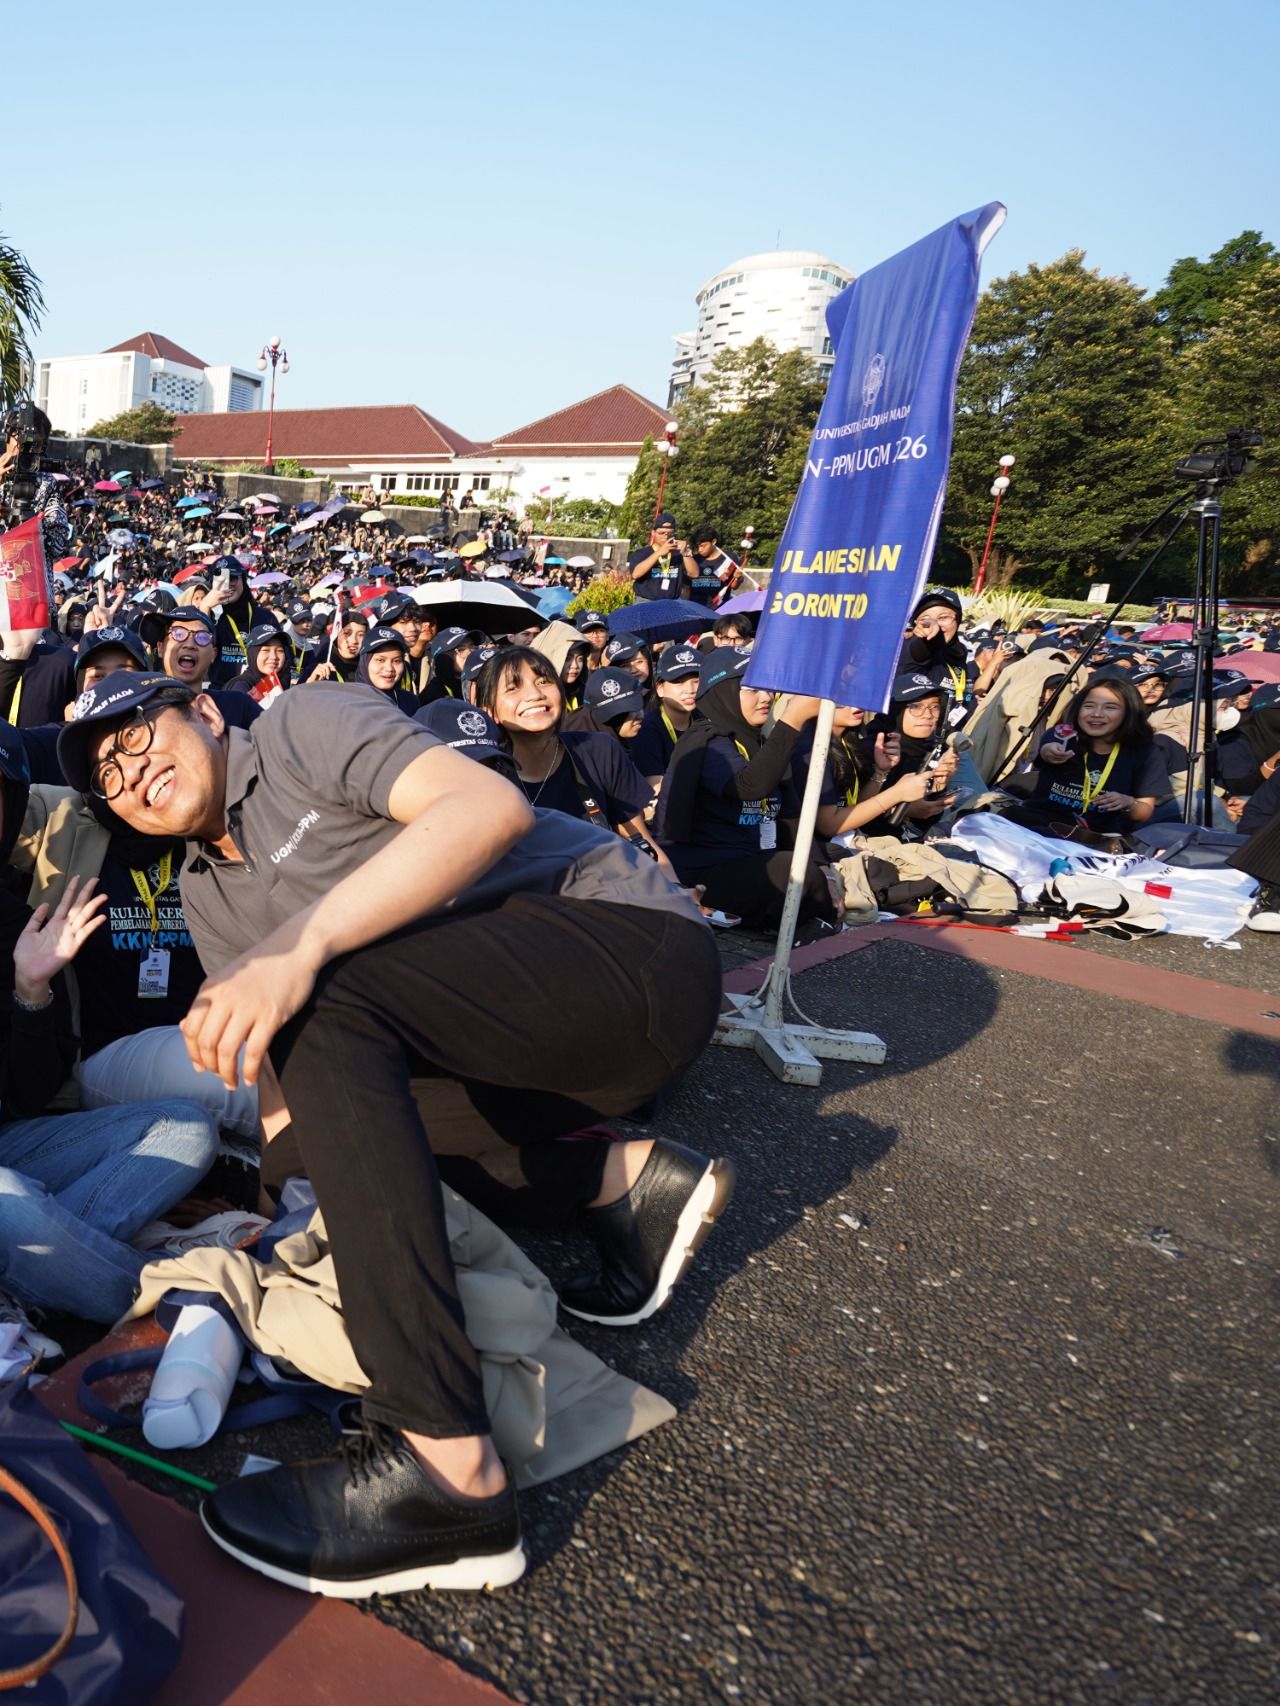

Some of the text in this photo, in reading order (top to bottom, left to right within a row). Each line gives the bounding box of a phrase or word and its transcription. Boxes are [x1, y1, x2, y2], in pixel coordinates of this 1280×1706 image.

[856, 443, 891, 471] UGM
[108, 688, 135, 703] MADA
[157, 906, 184, 919] KER
